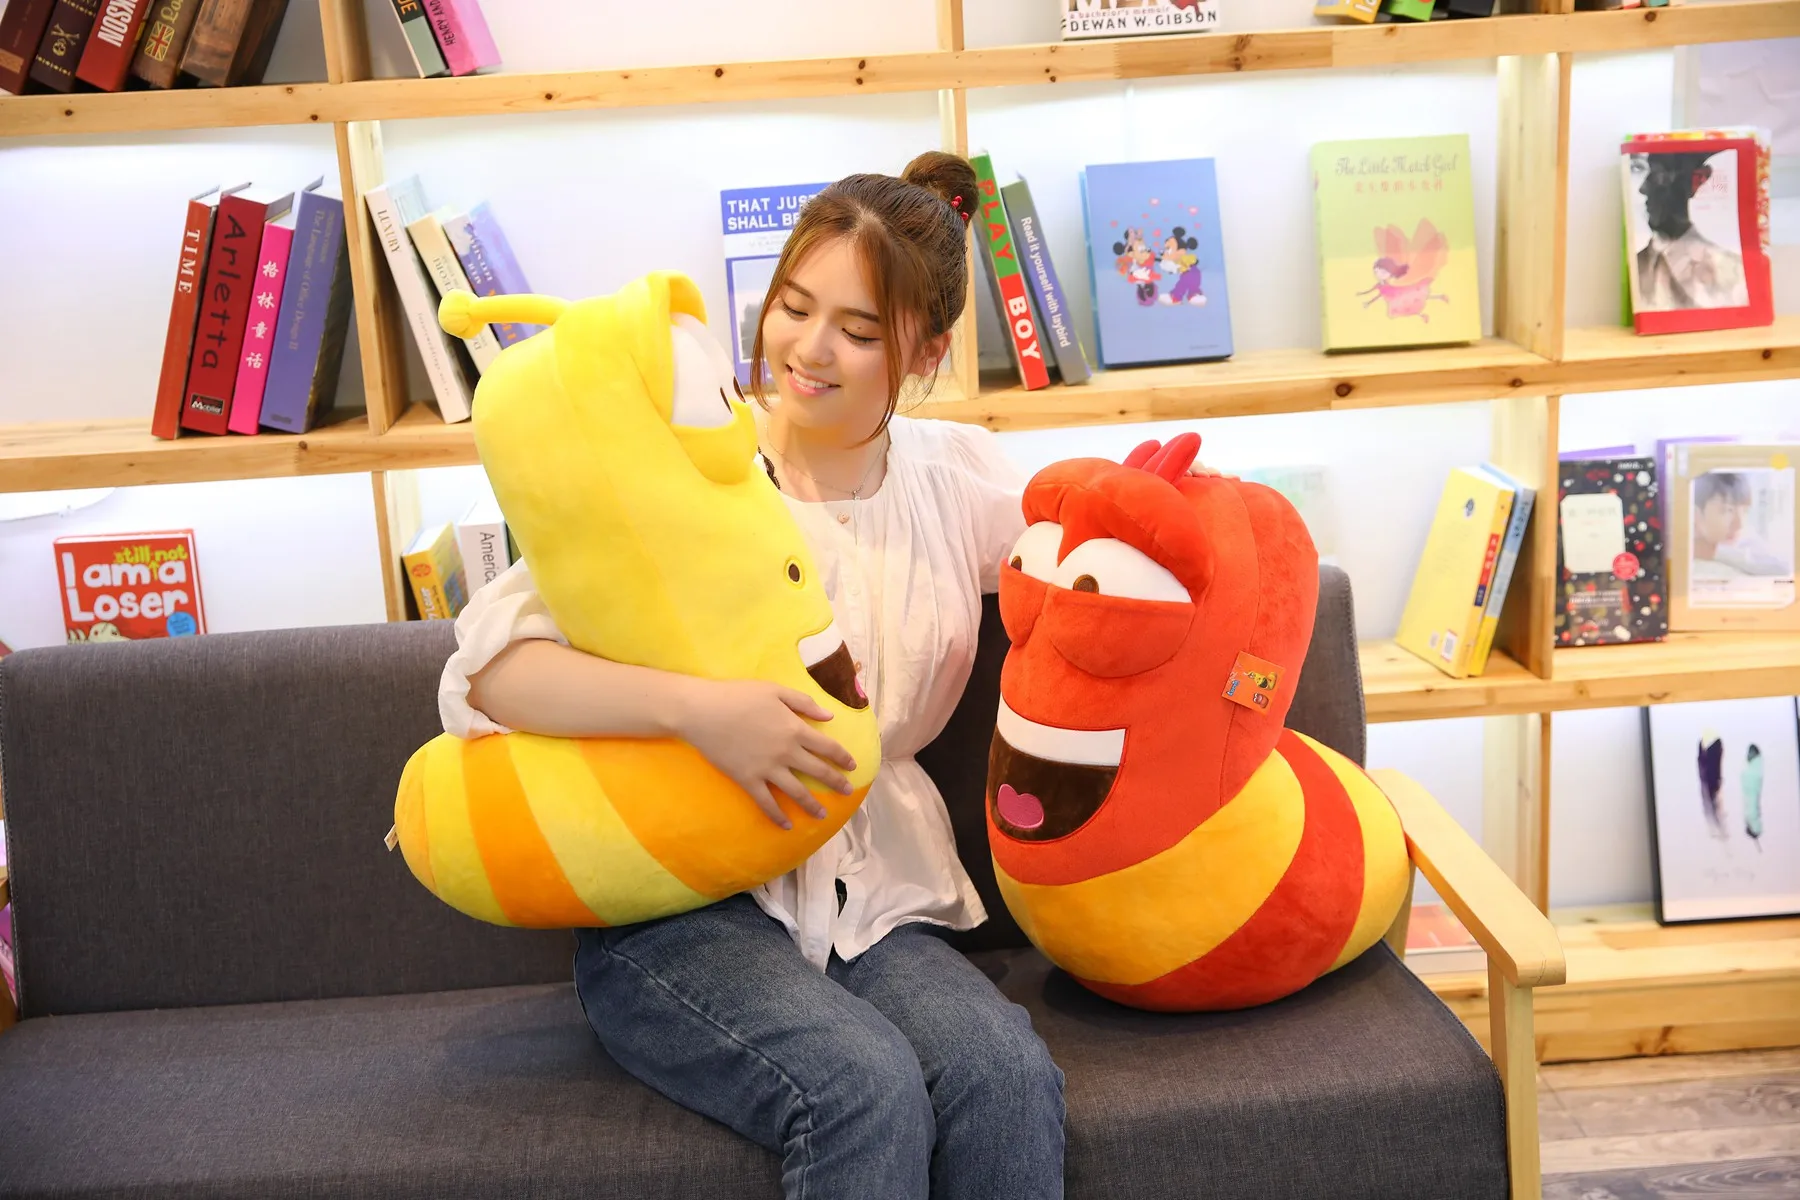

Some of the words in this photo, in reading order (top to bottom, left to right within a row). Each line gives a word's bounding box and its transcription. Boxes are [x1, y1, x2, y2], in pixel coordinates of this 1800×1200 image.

[98, 0, 139, 48] KSON
[160, 0, 187, 25] Lo
[1070, 17, 1127, 32] DEWAN
[1134, 16, 1150, 28] W.
[1155, 10, 1217, 26] GIBSON
[1079, 9, 1130, 19] bachelor's
[1133, 6, 1171, 15] memoir
[435, 19, 456, 46] HENRY
[727, 198, 770, 214] THAT
[727, 214, 778, 231] SHALL
[977, 178, 1015, 261] PLAY
[377, 208, 402, 253] LUXURY
[1020, 216, 1036, 243] Read
[177, 229, 201, 294] TIME
[1029, 243, 1040, 253] it
[1029, 251, 1052, 293] yourself
[201, 214, 247, 369] Arletta
[1045, 289, 1059, 313] with
[246, 260, 279, 370] 格林童话
[1007, 295, 1041, 360] BOY
[61, 552, 76, 588] I
[83, 562, 151, 588] am
[158, 560, 187, 584] a
[113, 545, 151, 563] still
[154, 543, 188, 561] not
[480, 531, 498, 584] Americ
[66, 588, 189, 622] Loser
